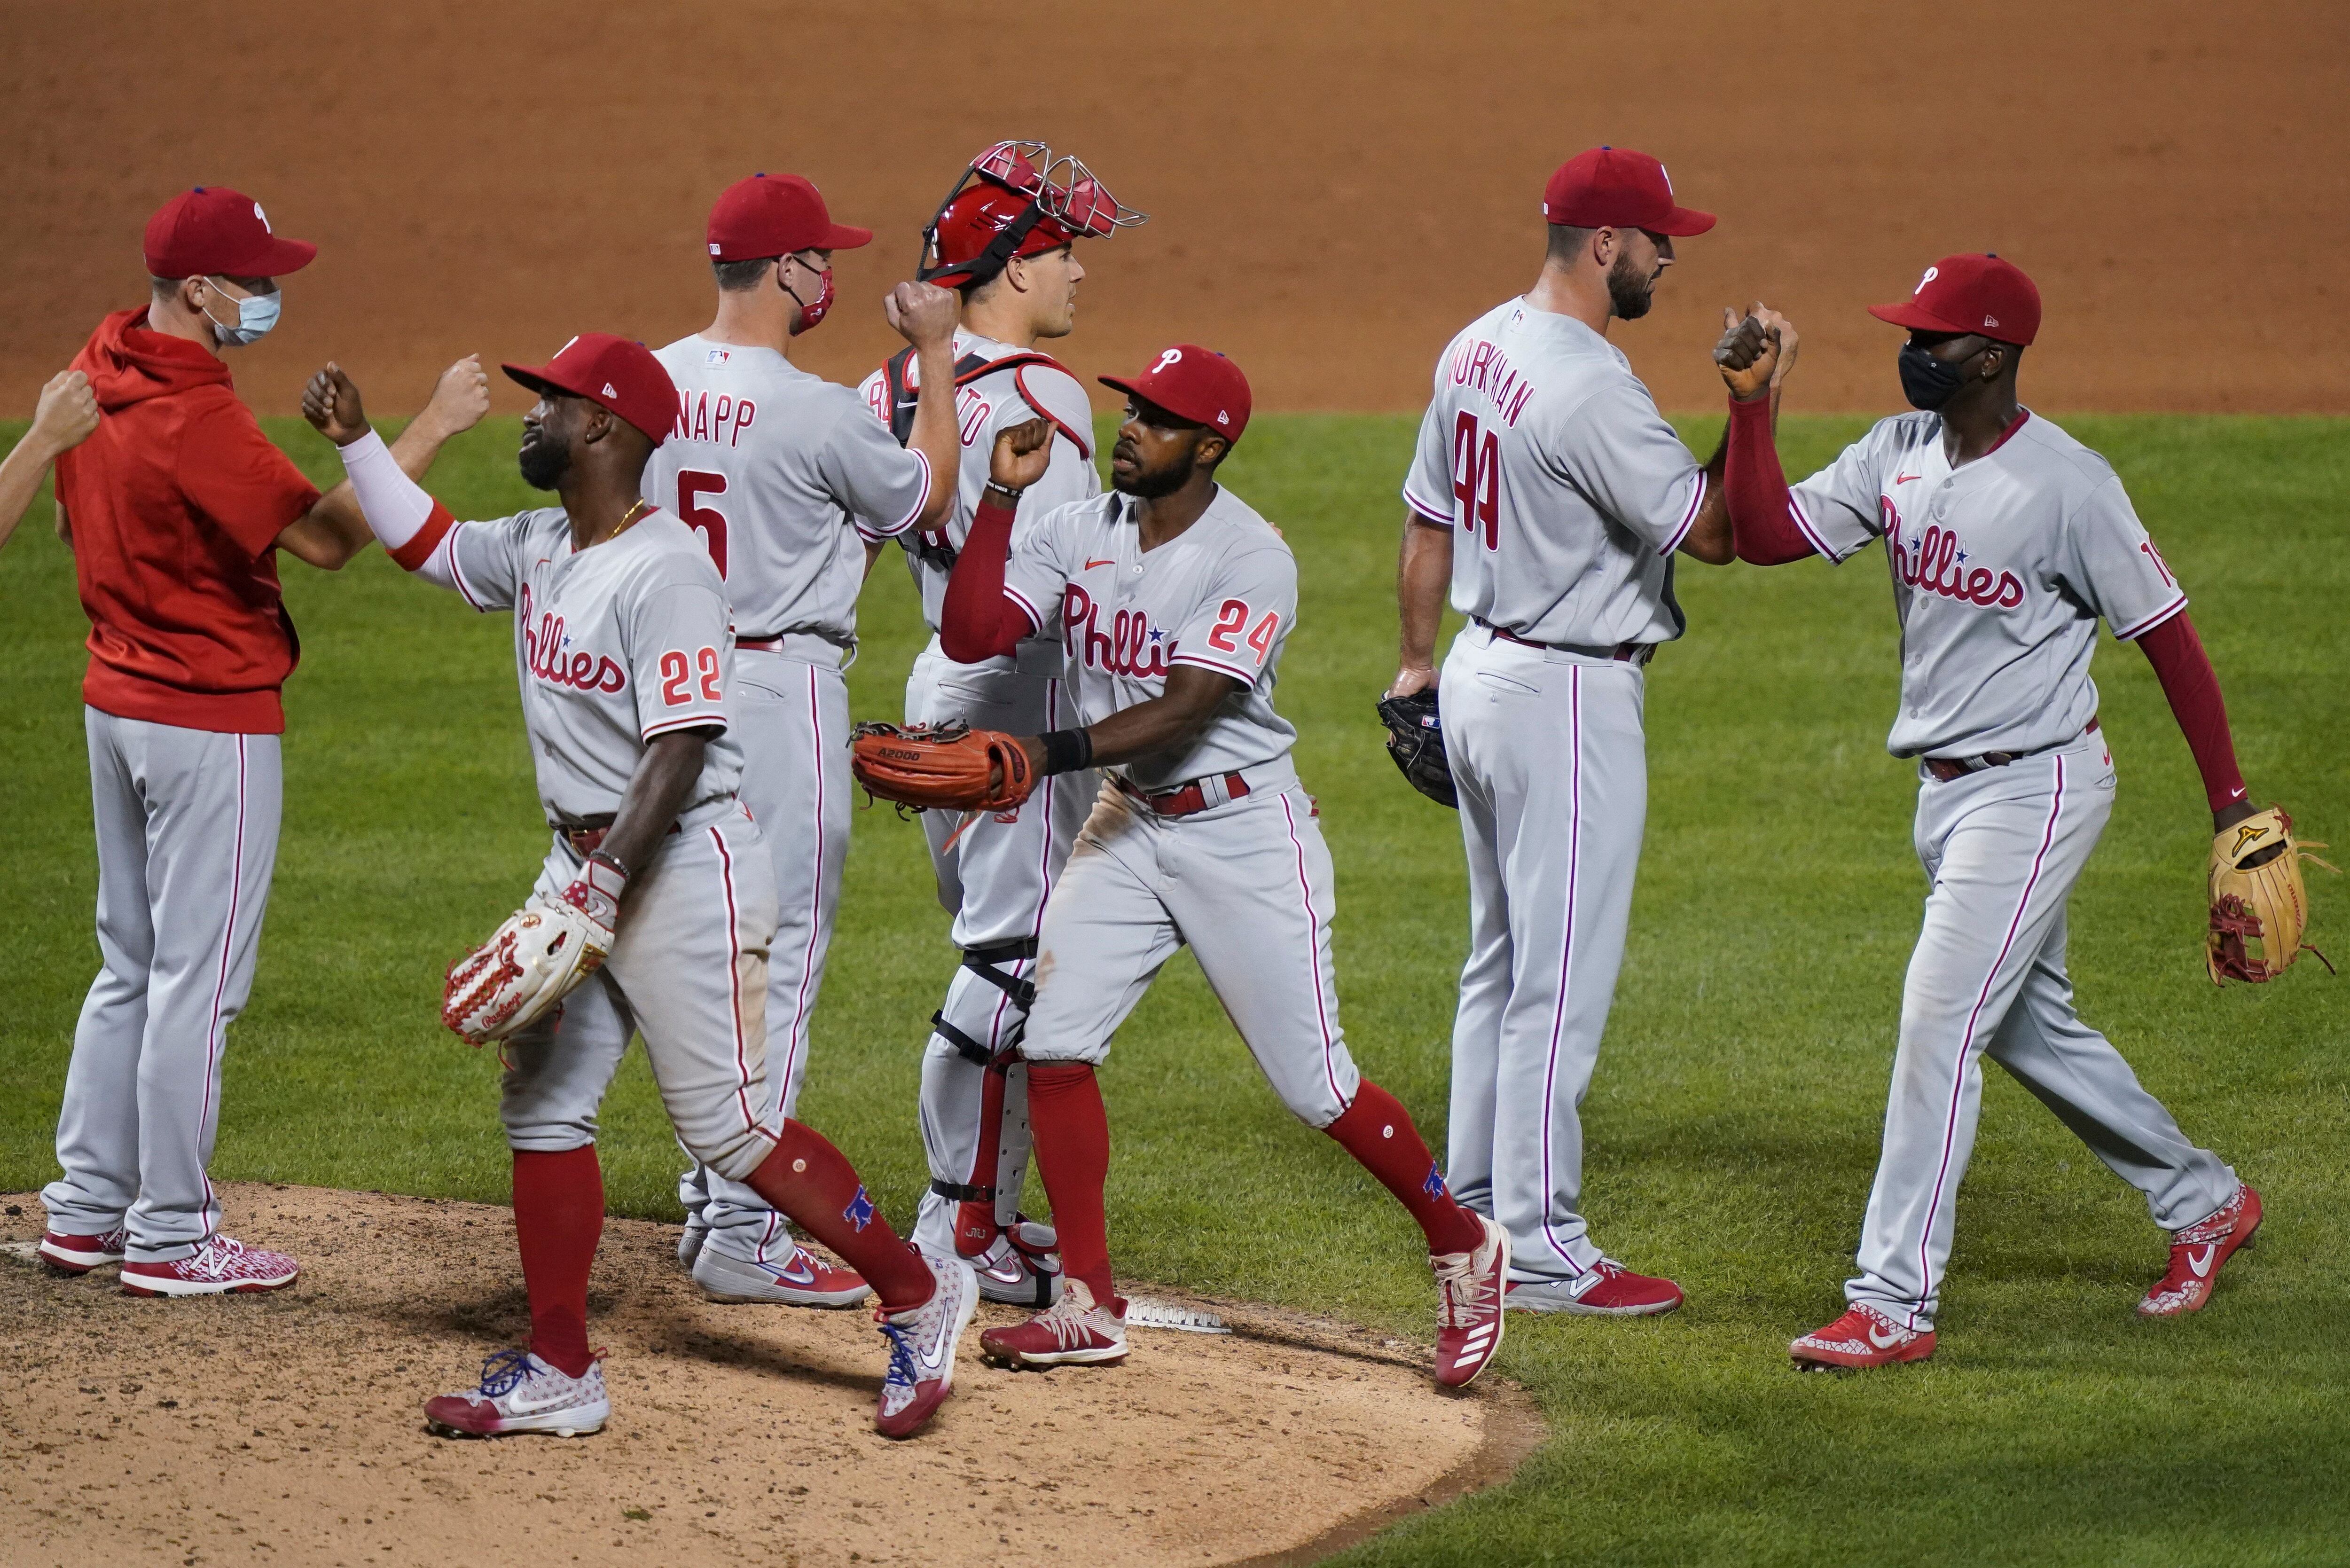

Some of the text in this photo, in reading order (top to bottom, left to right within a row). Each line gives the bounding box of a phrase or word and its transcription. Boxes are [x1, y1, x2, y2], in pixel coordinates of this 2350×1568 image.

[1914, 266, 1939, 295] P
[1152, 348, 1183, 374] P
[664, 388, 757, 449] NAPP
[1453, 408, 1500, 553] 44
[676, 468, 729, 584] 5
[2139, 531, 2178, 589] 1
[1207, 597, 1281, 667] 24
[658, 645, 723, 708] 22
[878, 747, 920, 761] A2000
